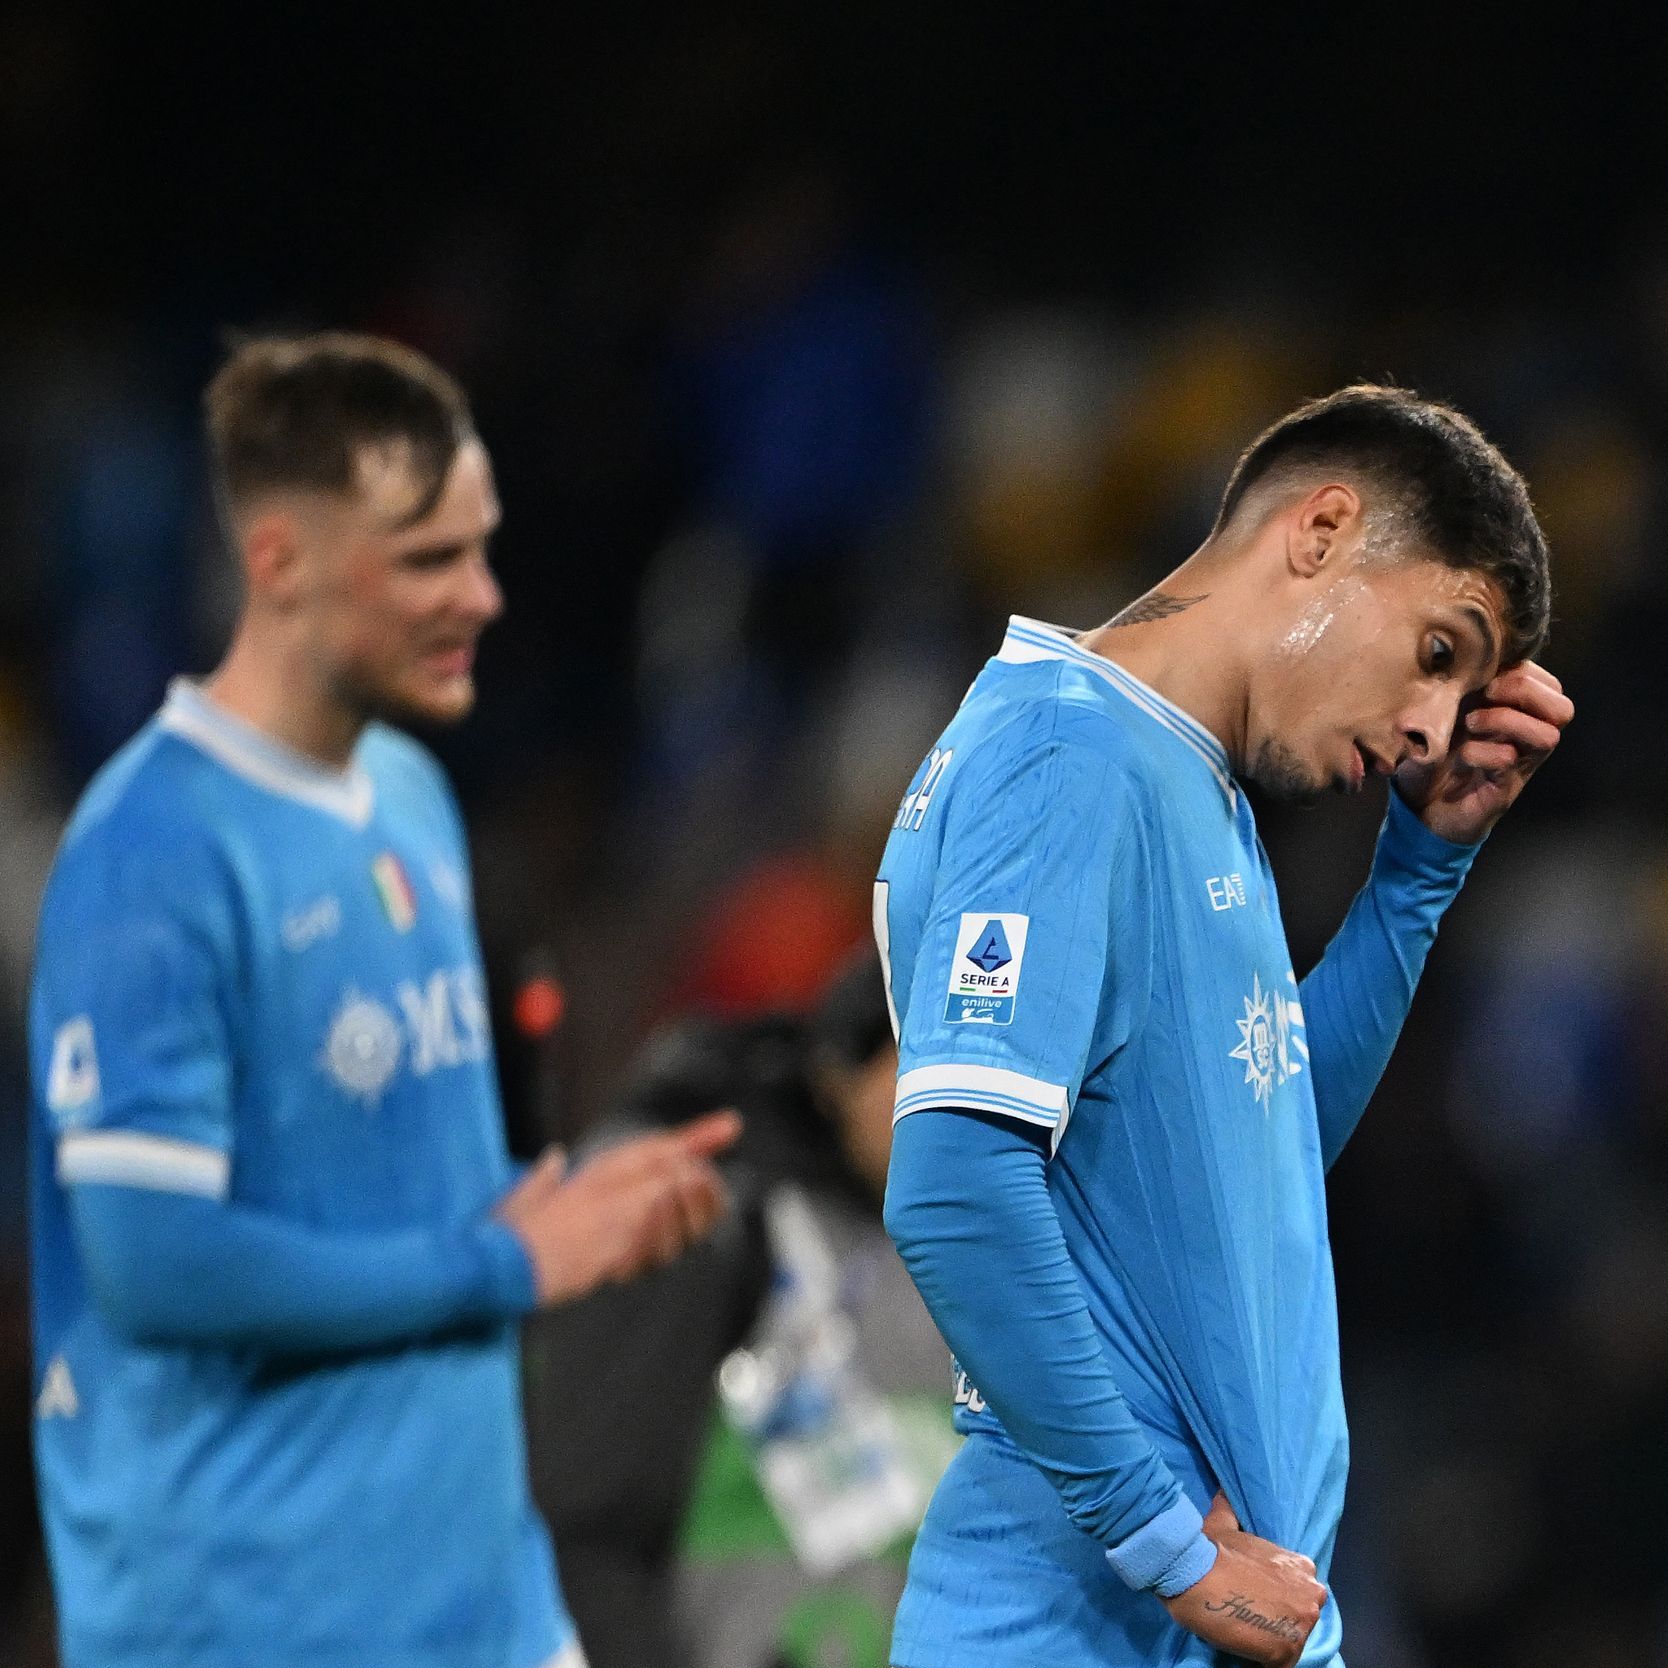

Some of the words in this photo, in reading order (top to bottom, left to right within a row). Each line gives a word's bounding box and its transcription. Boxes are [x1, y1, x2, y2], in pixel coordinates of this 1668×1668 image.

[960, 973, 999, 987] SERIE
[1001, 976, 1010, 987] A
[961, 998, 1002, 1008] enilive
